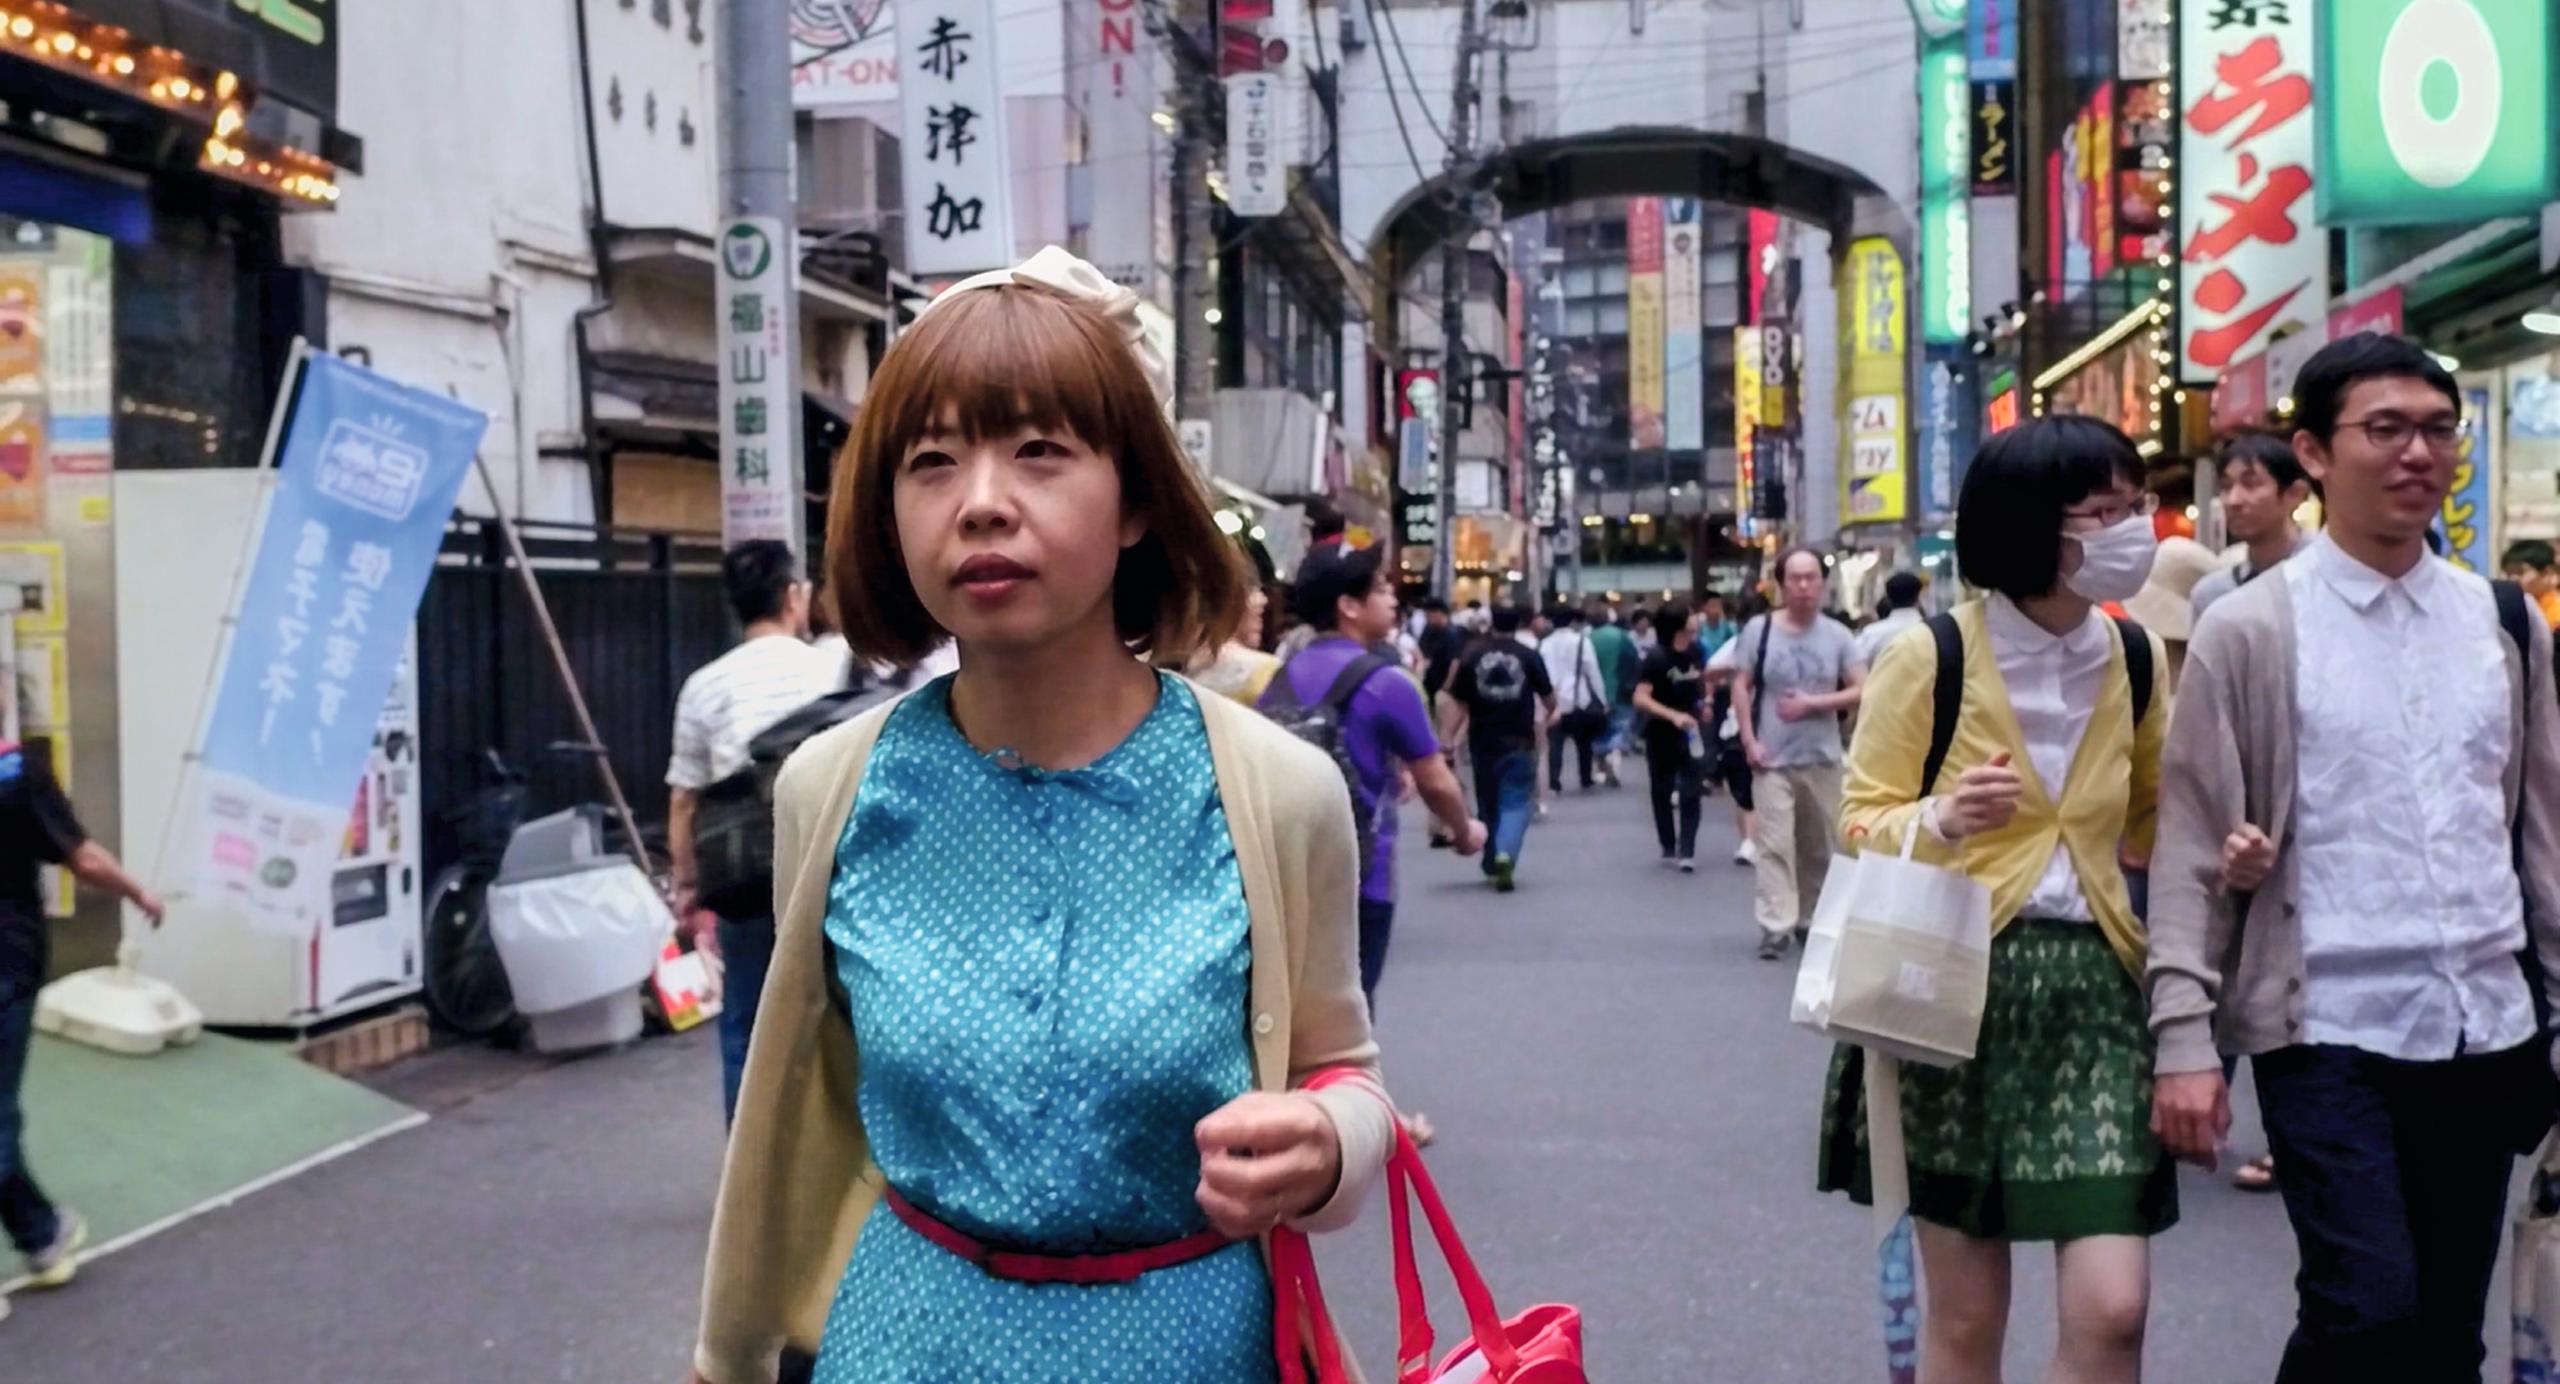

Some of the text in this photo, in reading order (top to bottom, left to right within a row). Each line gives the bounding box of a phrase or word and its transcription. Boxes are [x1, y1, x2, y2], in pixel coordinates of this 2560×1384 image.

[917, 16, 983, 241] 赤津加
[2184, 34, 2313, 367] ラーメン
[731, 293, 768, 487] 福山歯科
